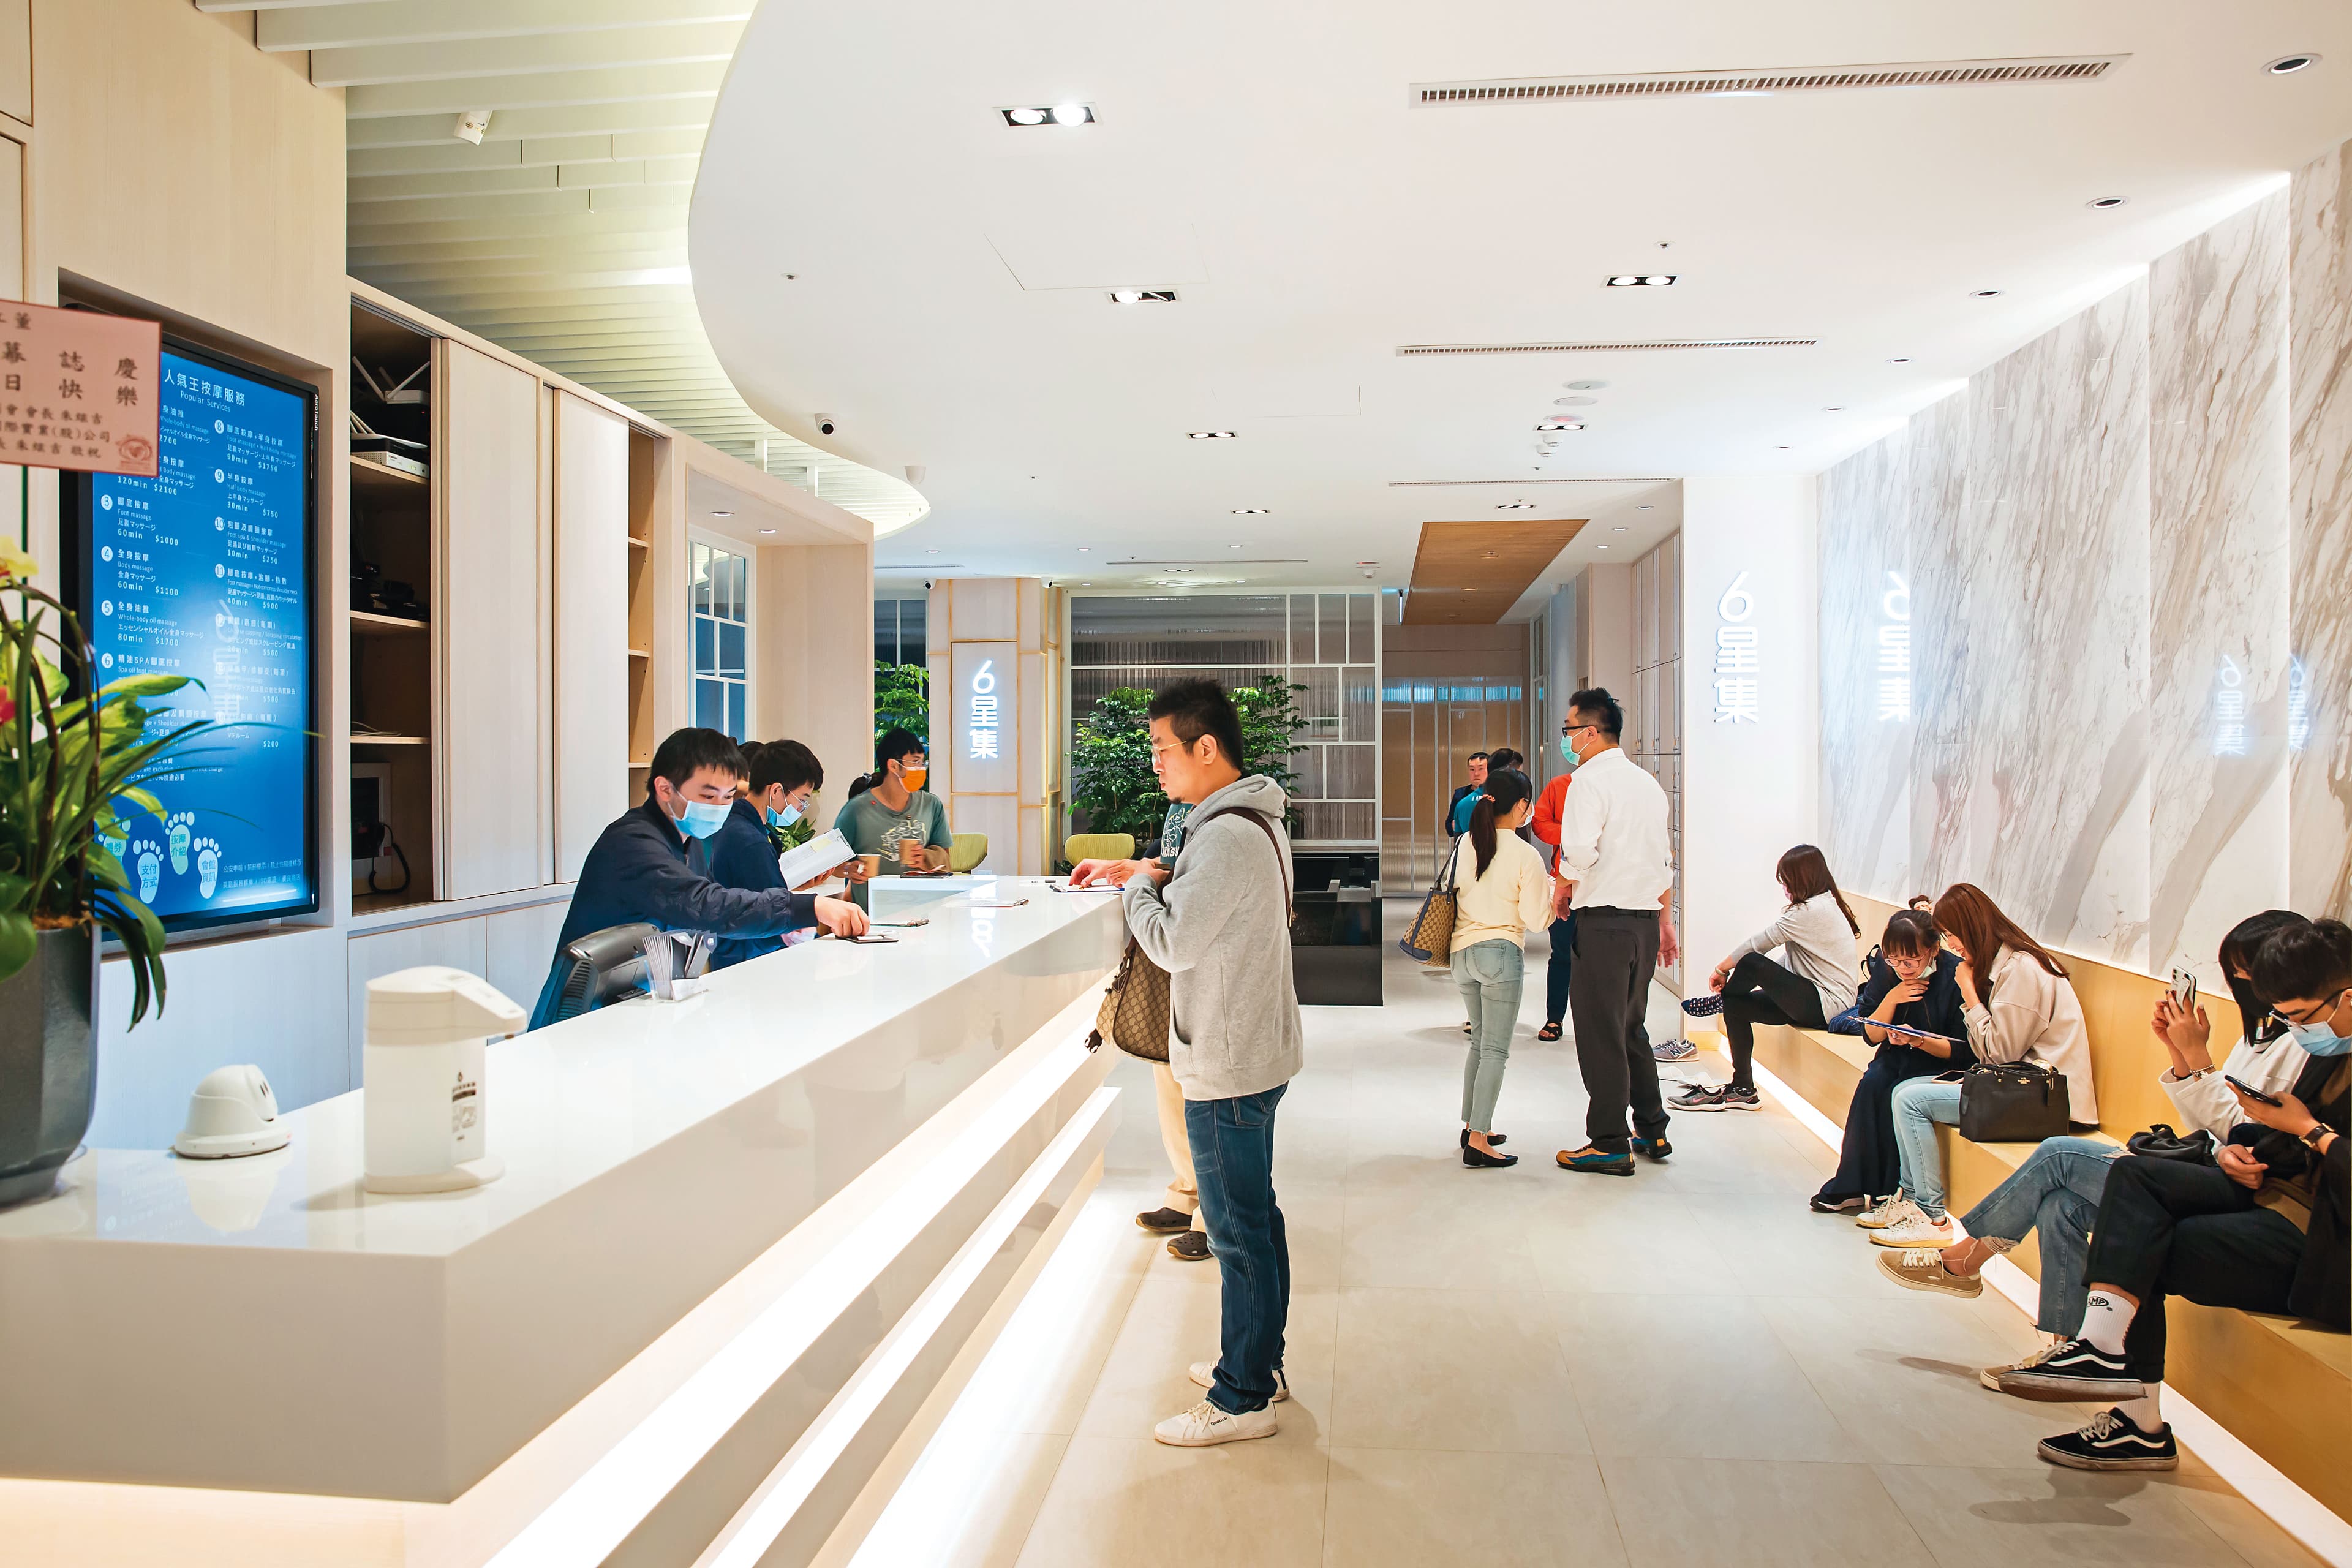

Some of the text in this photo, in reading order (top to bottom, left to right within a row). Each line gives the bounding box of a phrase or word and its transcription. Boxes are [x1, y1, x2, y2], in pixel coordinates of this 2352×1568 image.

[164, 369, 245, 407] 人氣王按摩服務
[181, 390, 231, 412] Popular Services
[227, 453, 278, 472] 90min $1750
[163, 466, 175, 475] Body
[176, 470, 196, 480] massage
[118, 476, 177, 496] 120min $2100
[130, 512, 152, 521] massage
[227, 501, 278, 519] 30min $750
[118, 528, 178, 546] 60min $1000
[118, 549, 149, 562] 全身按摩
[227, 549, 278, 564] 10min $250
[132, 564, 153, 573] massage
[118, 570, 156, 582] 全身マッサージ
[118, 581, 179, 596] 60min $1100
[118, 601, 149, 613] 全身油推
[227, 597, 248, 607] 40min
[118, 614, 148, 623] Whole-body
[118, 633, 179, 646] 80min $1700
[263, 648, 279, 657] $500
[1713, 571, 1760, 723] 6星集
[969, 660, 998, 760] 6星集
[172, 834, 186, 845] 按摩
[172, 846, 186, 858] 介紹
[141, 864, 157, 875] 支付
[141, 876, 157, 888] 方式
[1210, 1417, 1228, 1426] Reebok
